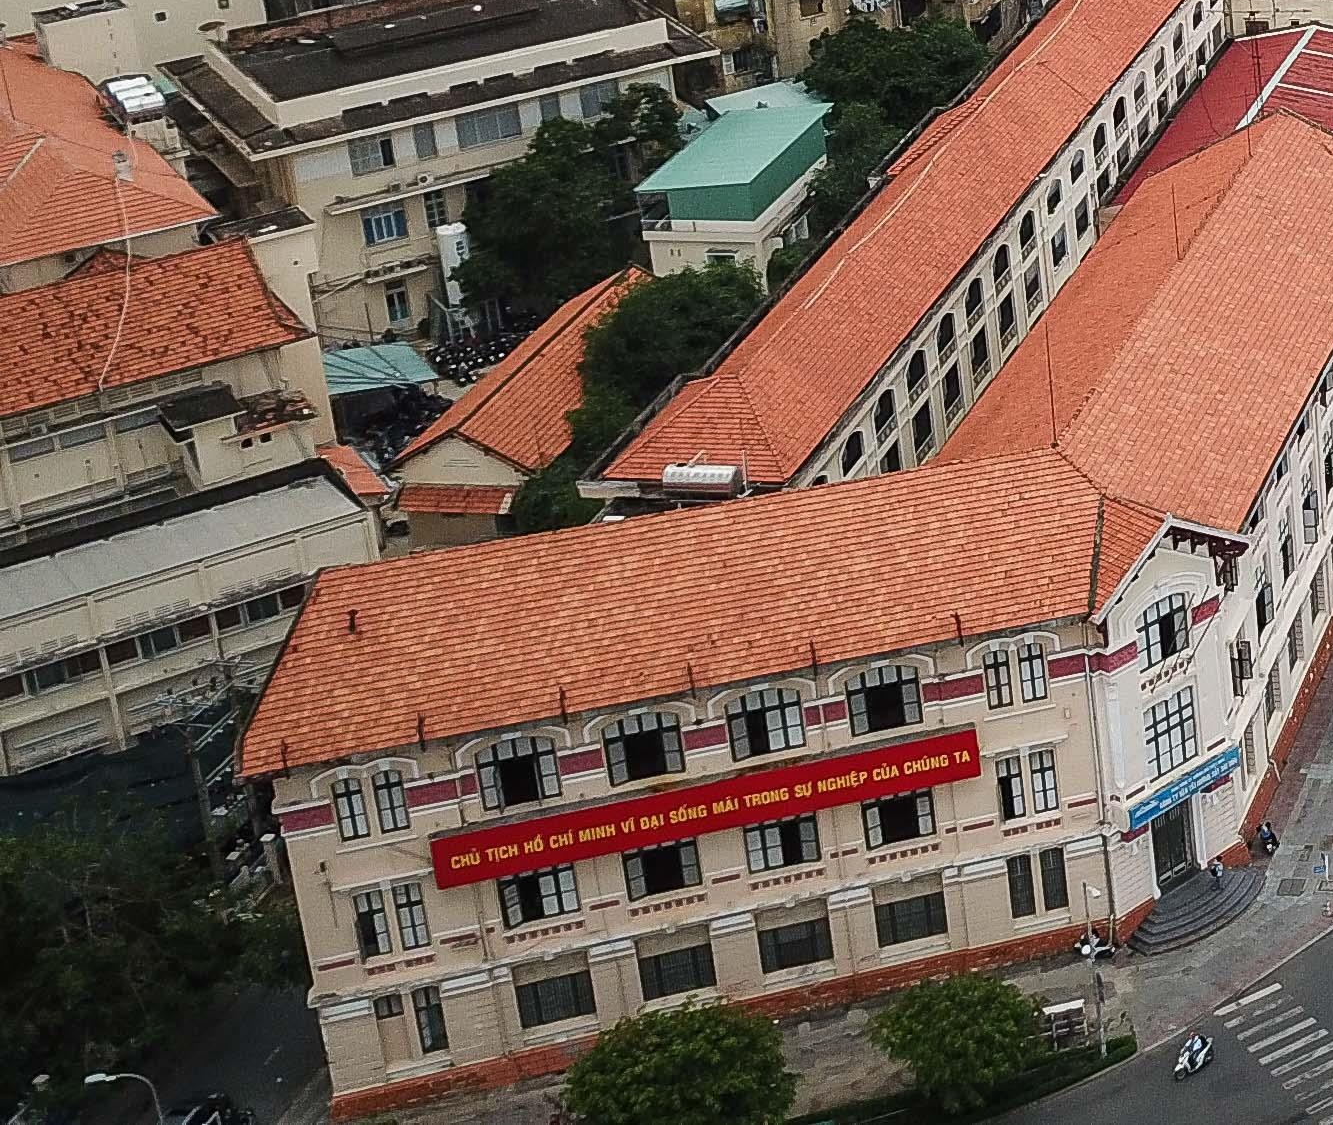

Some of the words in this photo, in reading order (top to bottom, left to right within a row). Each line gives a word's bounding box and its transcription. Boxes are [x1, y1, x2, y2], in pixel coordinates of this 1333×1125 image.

[451, 847, 481, 869] CHỦ
[485, 843, 518, 863] TỊCH
[524, 835, 545, 854] HỒ
[550, 832, 574, 850] CHÍ
[579, 823, 616, 843] MINH
[640, 814, 665, 831] ĐẠI
[670, 803, 707, 823] SỐNG
[745, 787, 789, 807] TRONG
[795, 781, 813, 798] SỰ
[818, 770, 868, 793] NGHIỆP
[872, 763, 900, 781] CỦA
[903, 754, 950, 775] CHÚNG
[953, 750, 971, 763] TA
